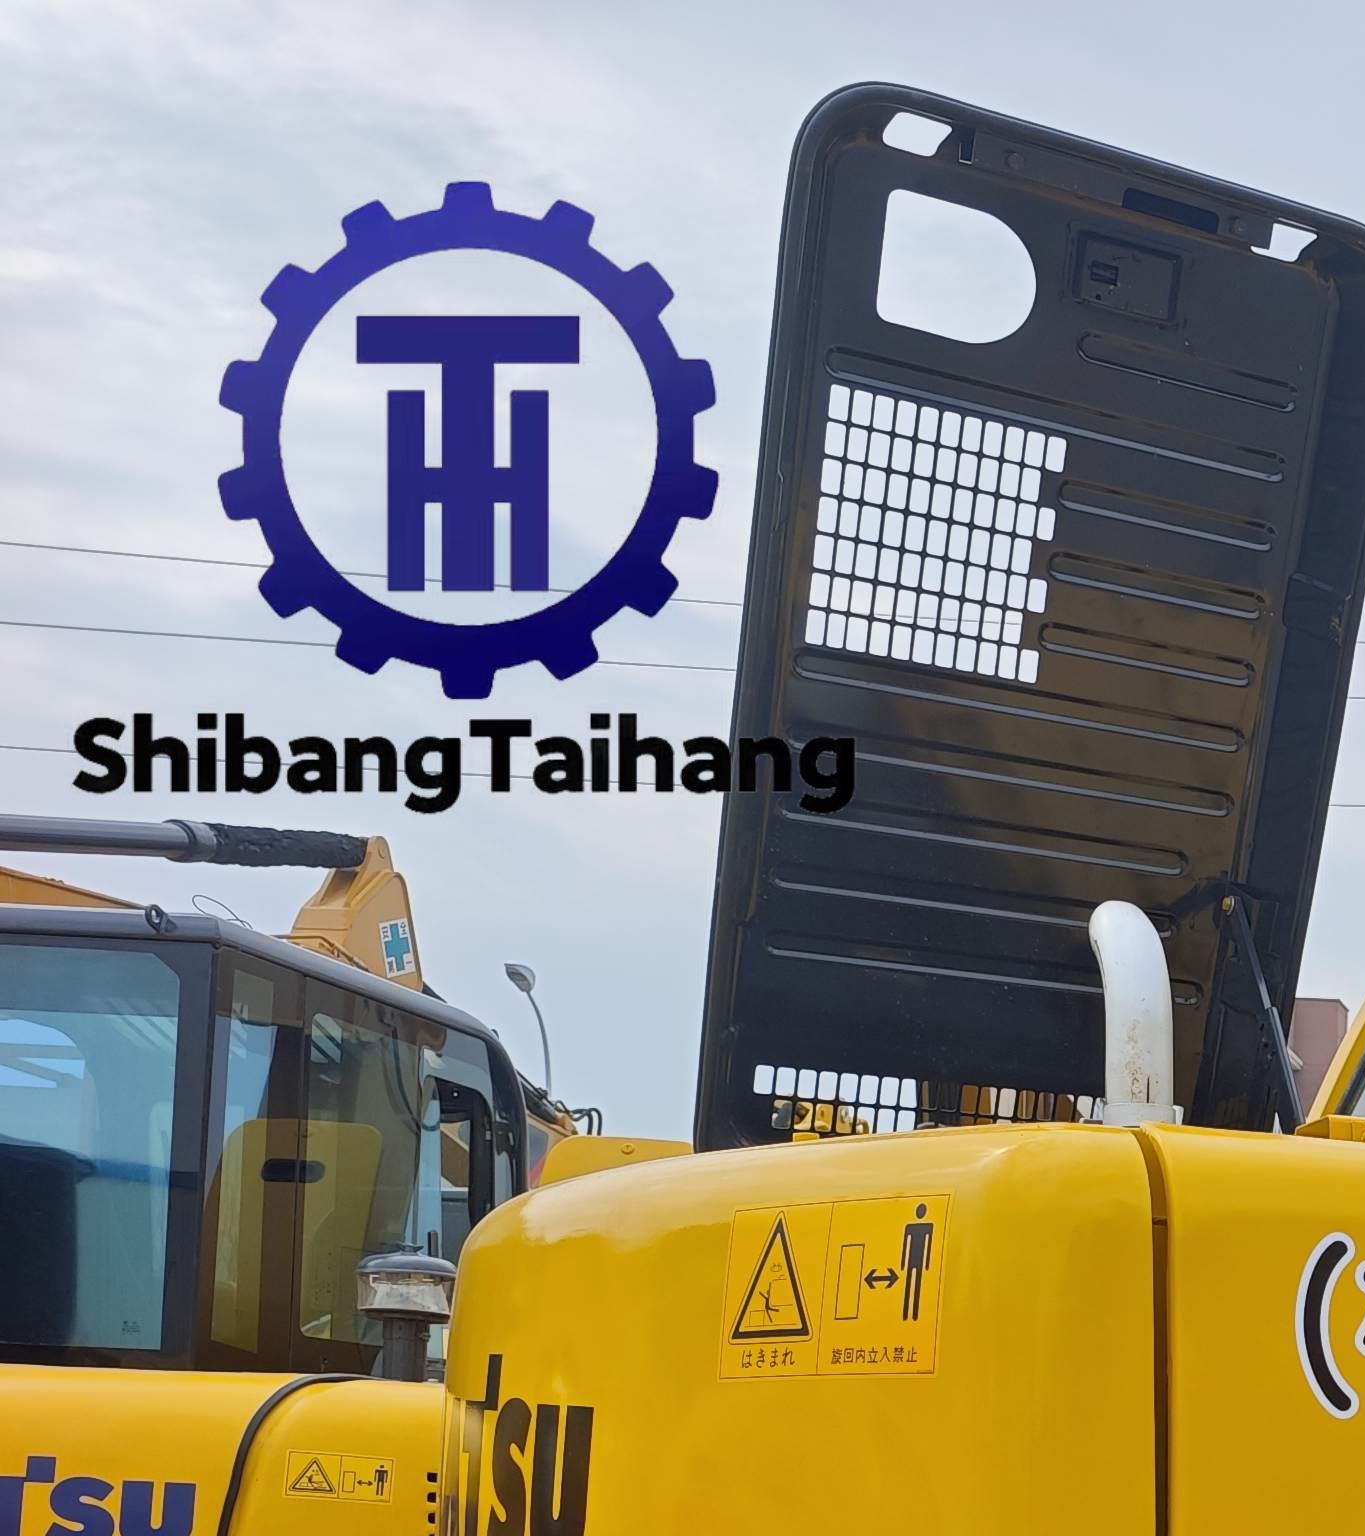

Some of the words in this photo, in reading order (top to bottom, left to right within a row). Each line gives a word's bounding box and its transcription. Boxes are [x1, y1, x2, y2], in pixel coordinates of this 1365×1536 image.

[831, 1346, 918, 1364] 旋回内立入禁止
